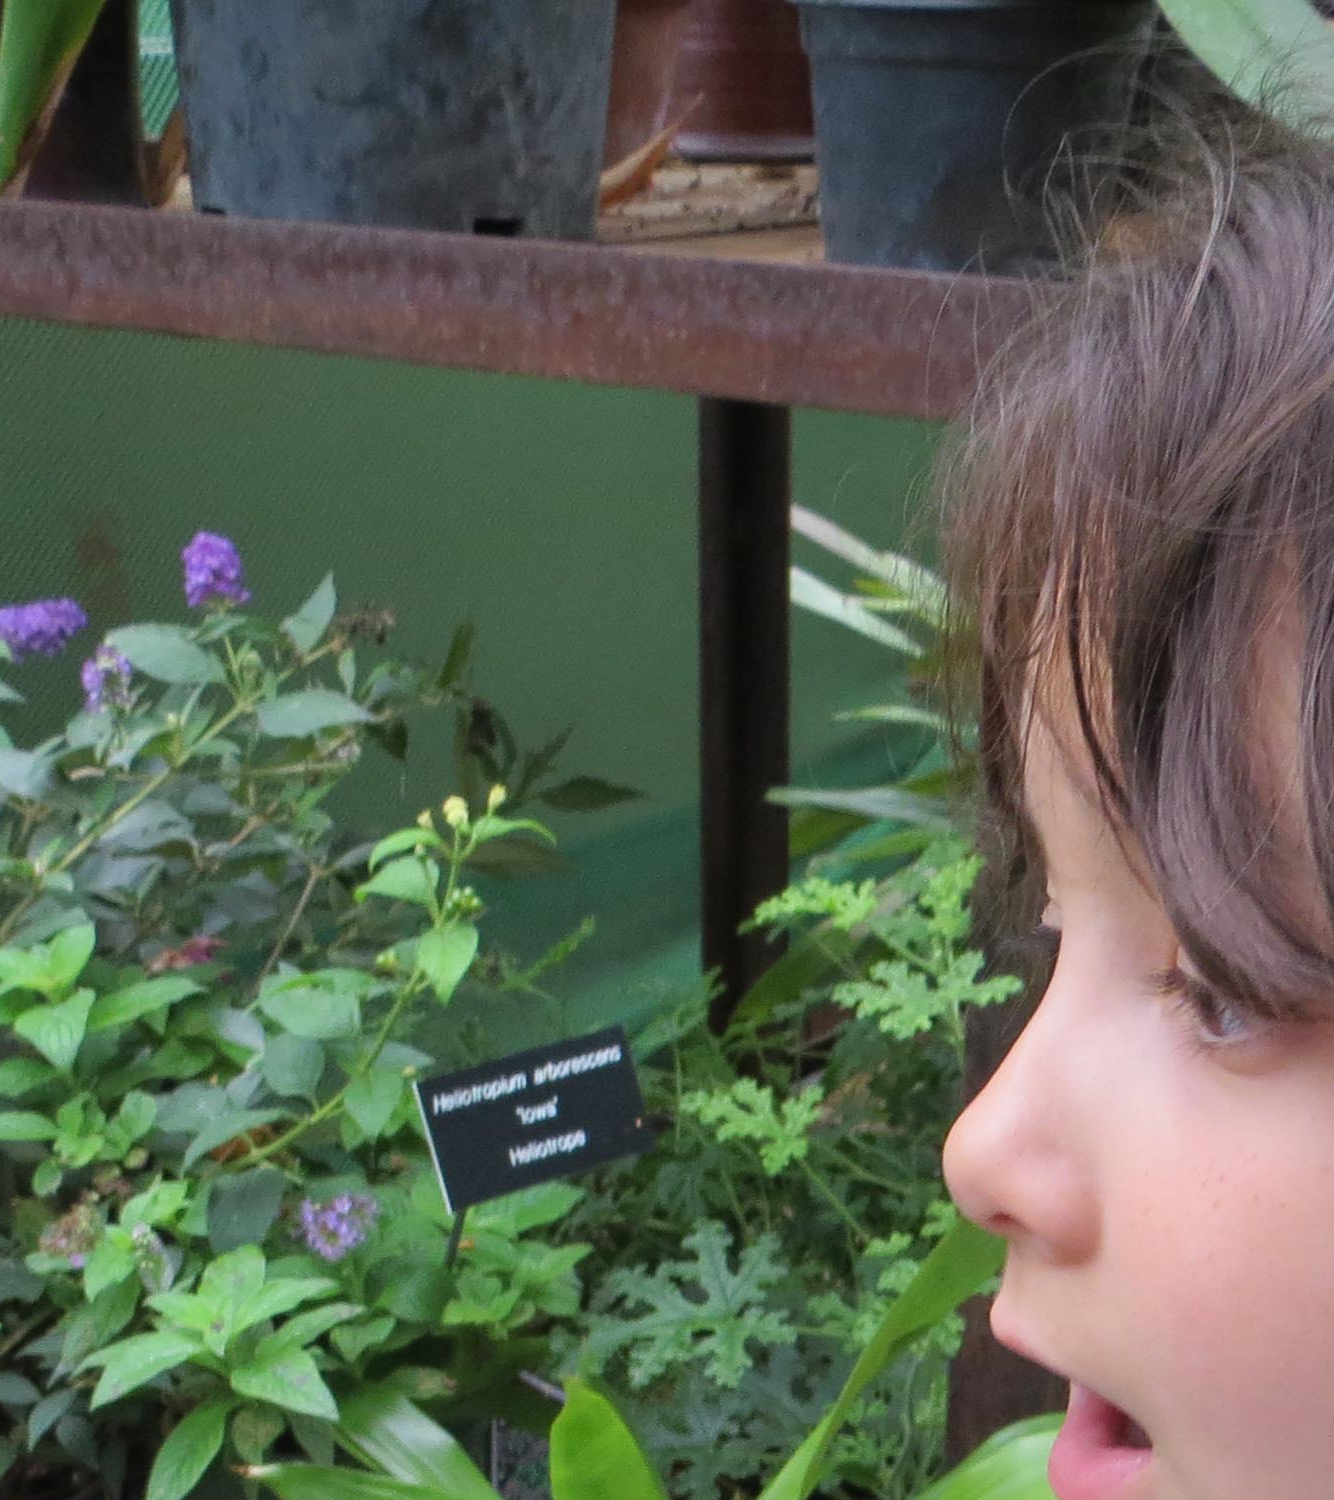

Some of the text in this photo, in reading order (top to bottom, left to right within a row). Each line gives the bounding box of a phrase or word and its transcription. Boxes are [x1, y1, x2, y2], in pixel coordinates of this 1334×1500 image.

[432, 1044, 622, 1115] Heliotropium arborescens
[508, 1129, 586, 1167] Heliotrope
